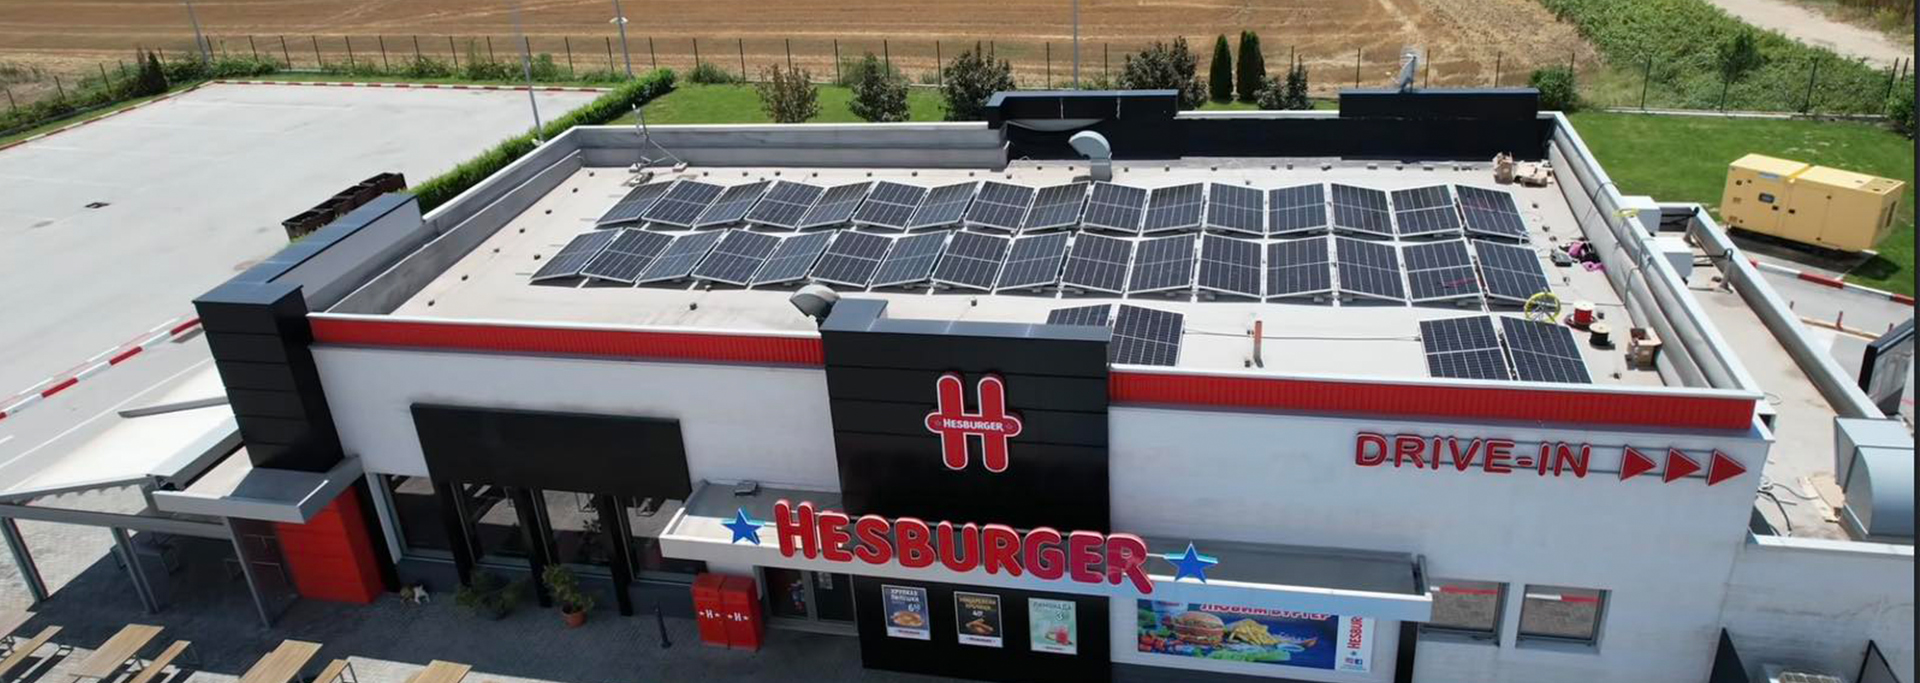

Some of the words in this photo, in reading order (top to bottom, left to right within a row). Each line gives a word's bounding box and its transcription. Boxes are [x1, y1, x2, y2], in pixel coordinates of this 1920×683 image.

[943, 418, 1005, 433] HESBURGER
[1355, 431, 1592, 479] DRIVE-IN
[774, 498, 1154, 595] HESBURGER
